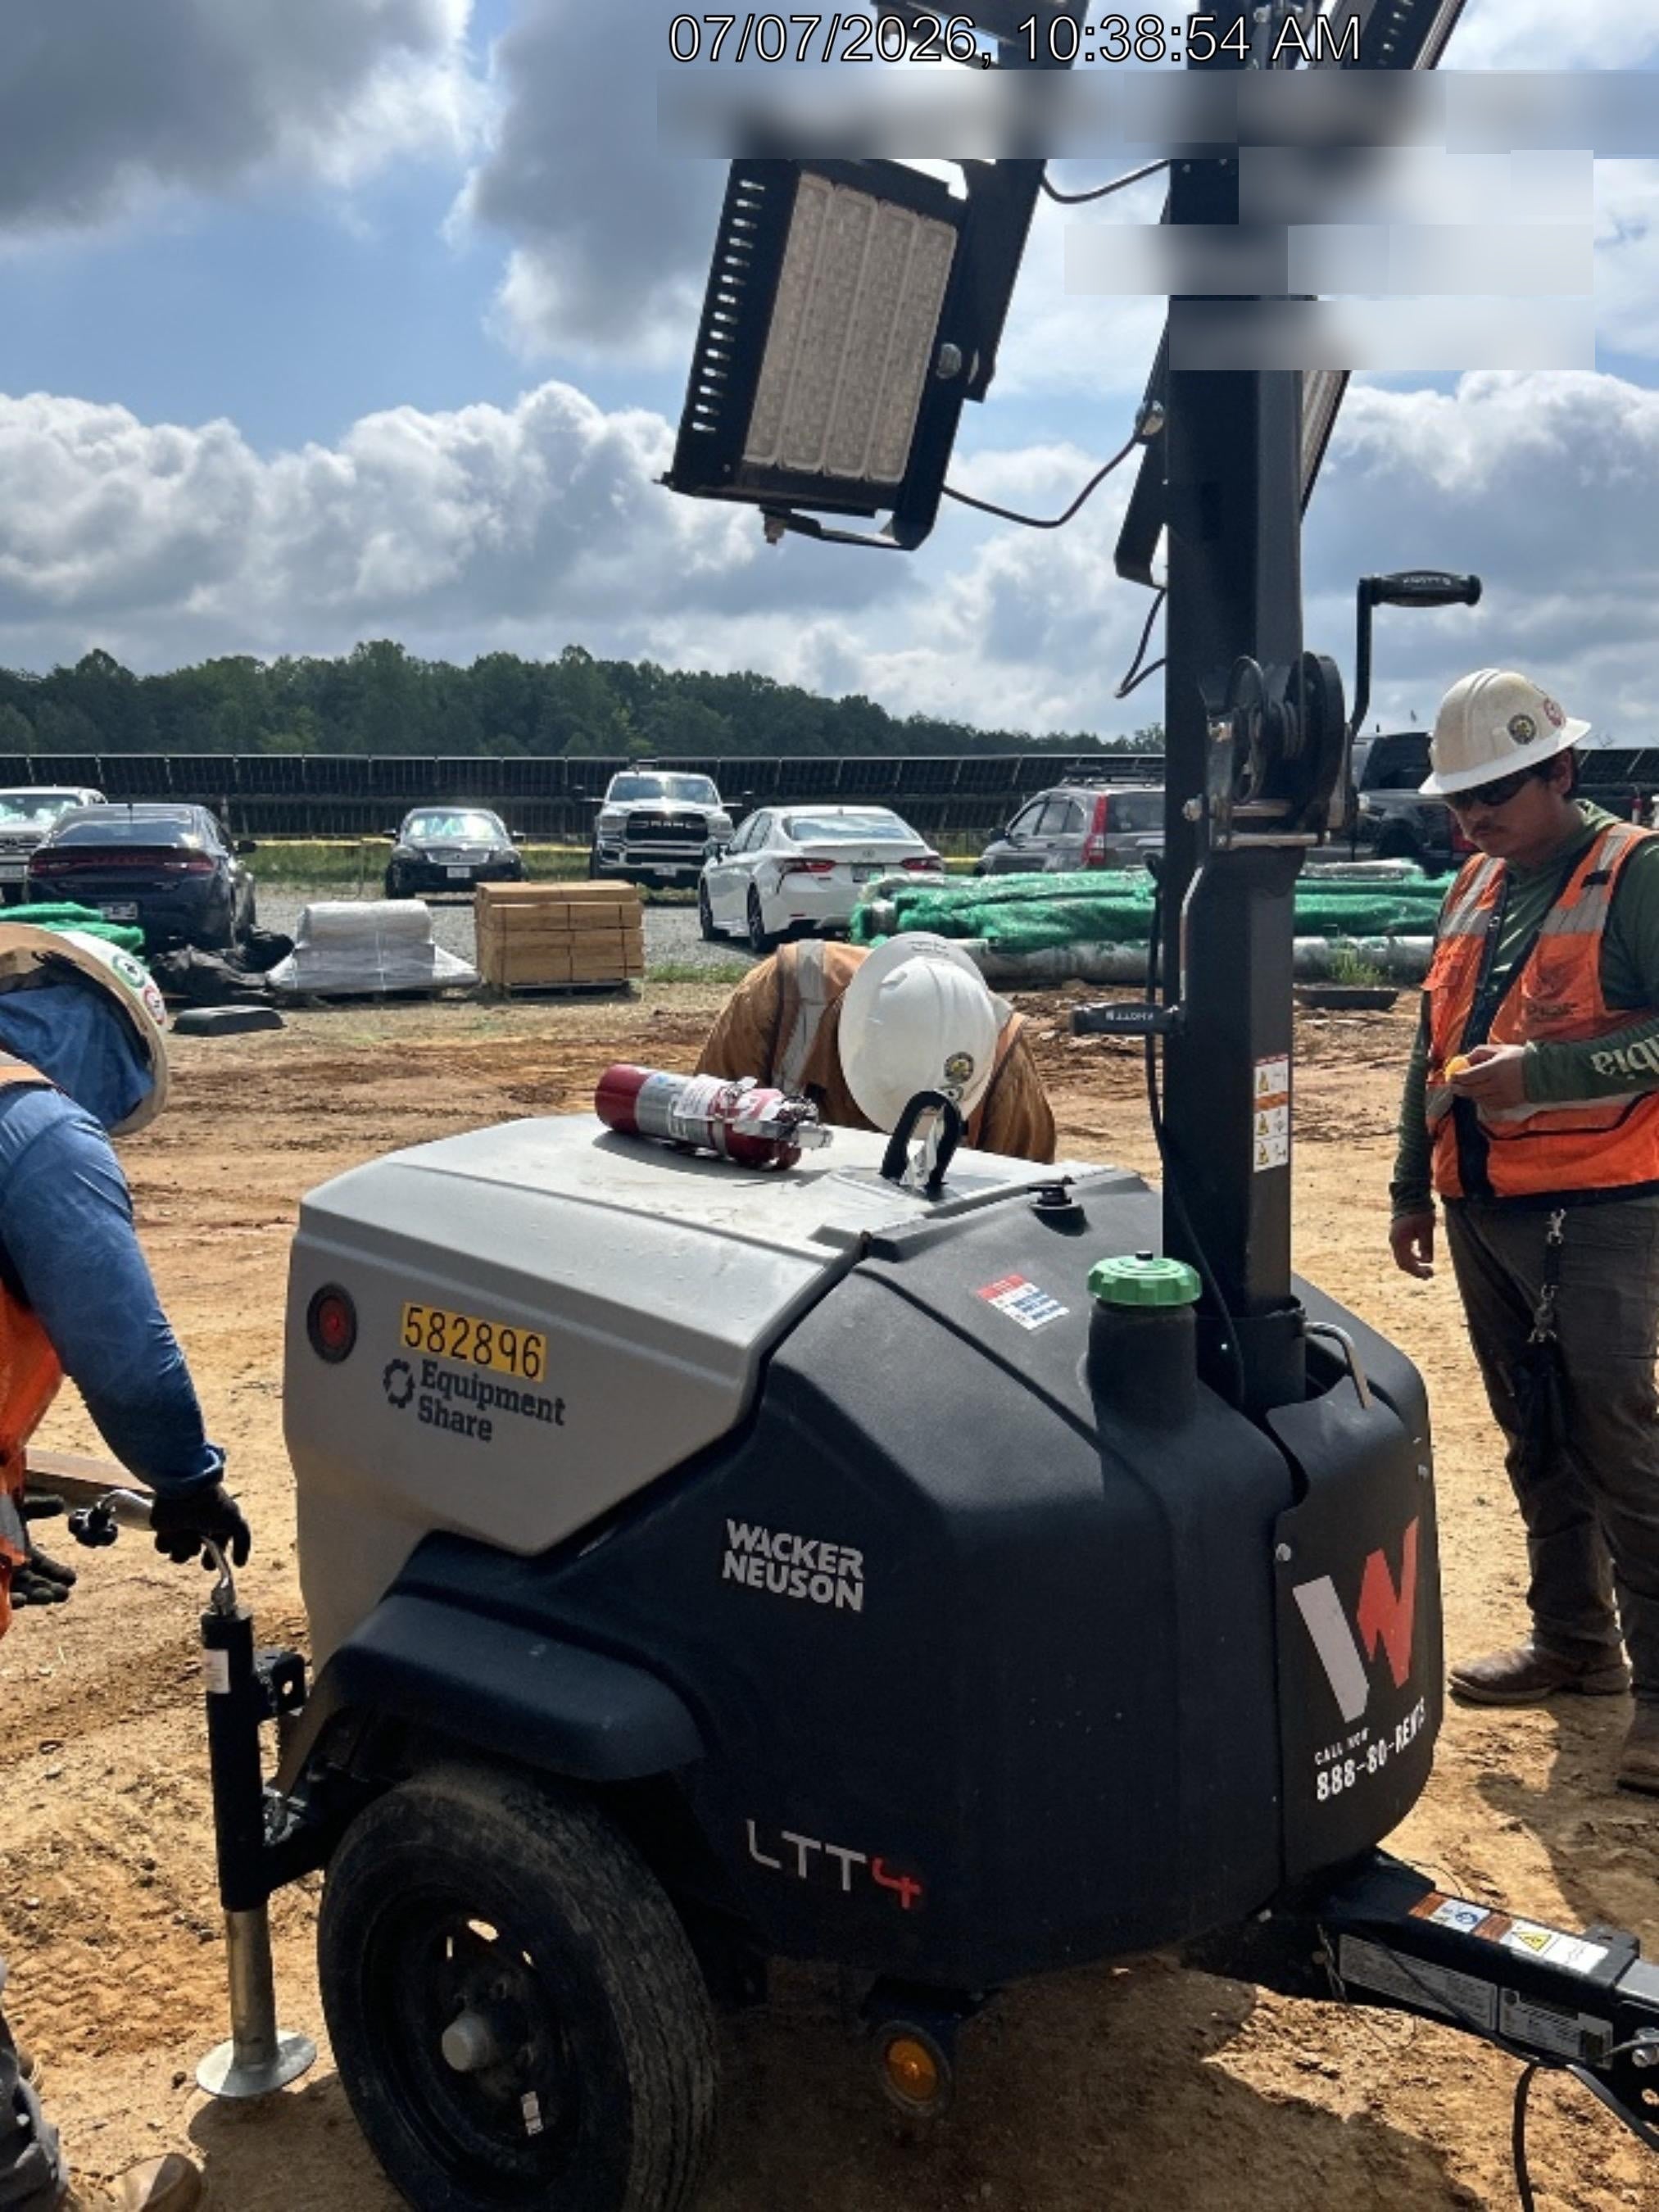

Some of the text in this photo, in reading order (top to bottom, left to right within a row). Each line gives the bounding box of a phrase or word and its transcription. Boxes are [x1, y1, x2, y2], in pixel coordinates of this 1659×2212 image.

[404, 1306, 542, 1380] 582896
[417, 1394, 493, 1443] Share
[419, 1358, 566, 1426] Equipment
[722, 1549, 864, 1613] NEUSON
[726, 1518, 864, 1580] WACKER
[1314, 1742, 1344, 1766] CALL
[746, 1818, 922, 1910] LTT4
